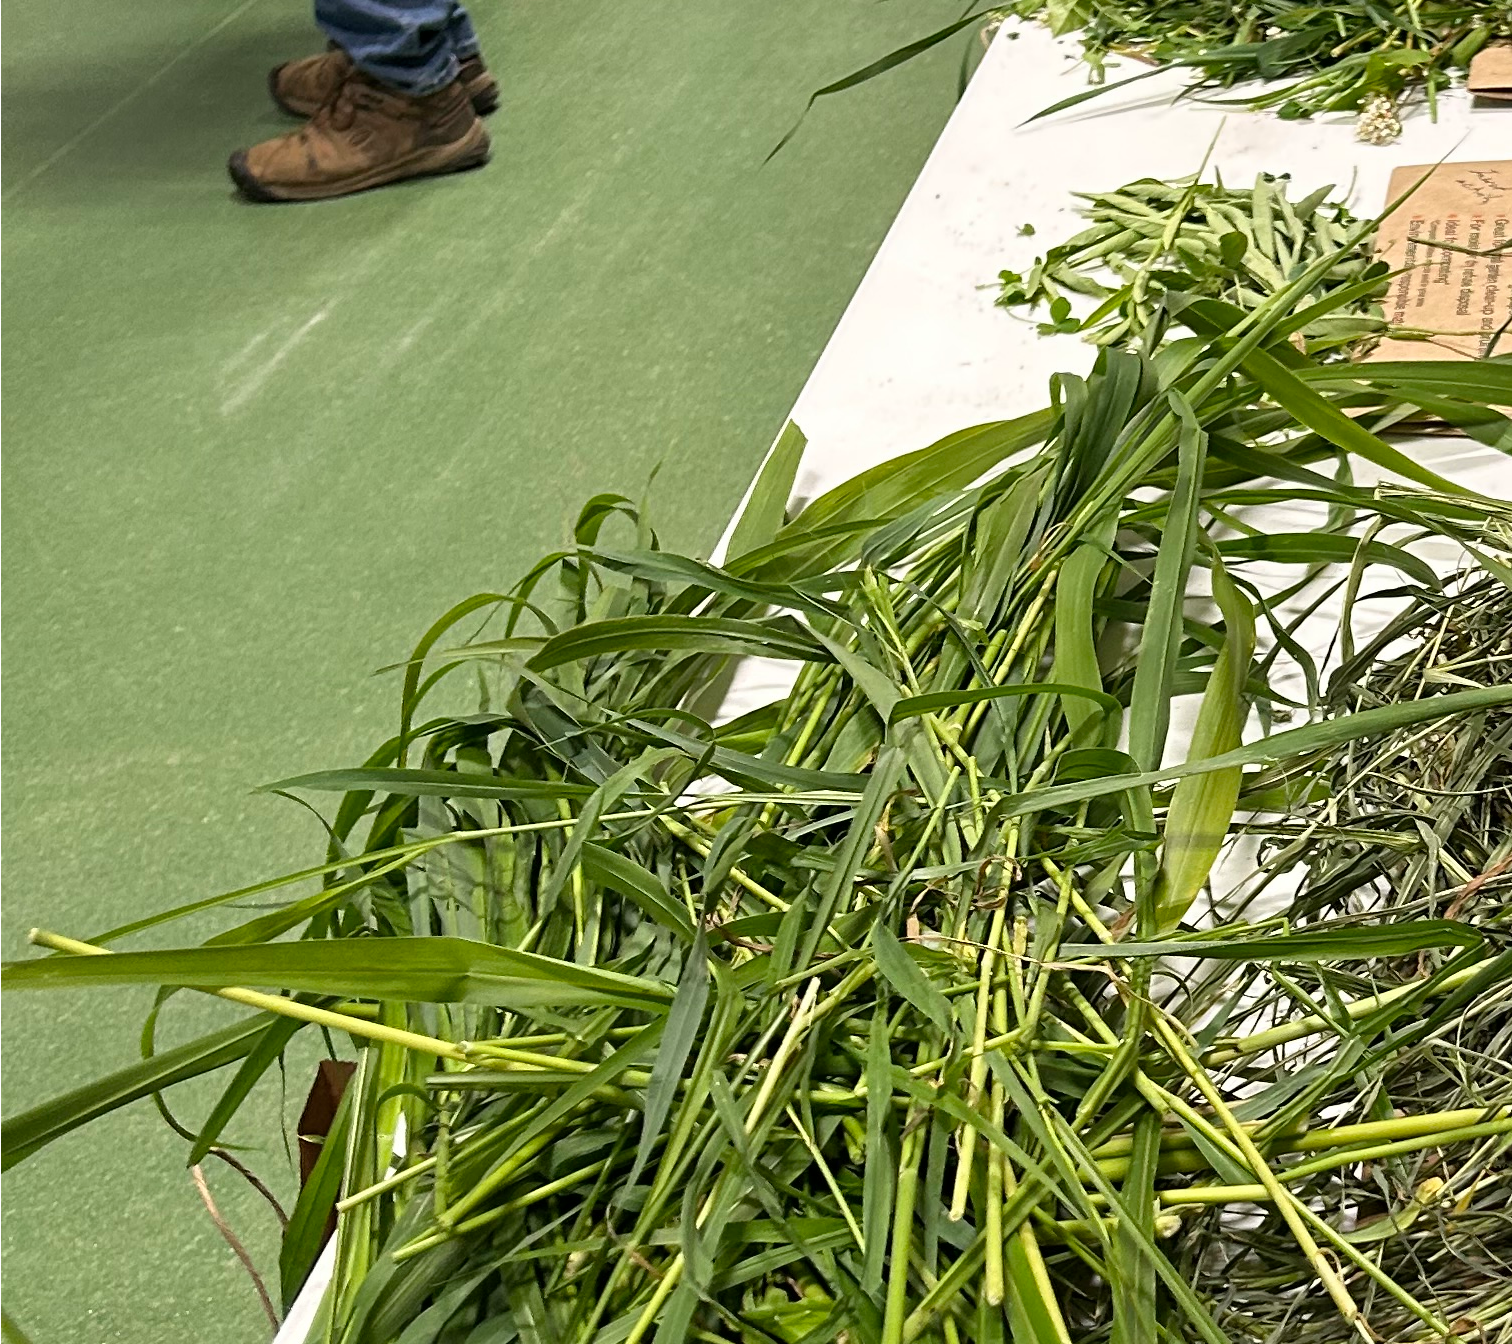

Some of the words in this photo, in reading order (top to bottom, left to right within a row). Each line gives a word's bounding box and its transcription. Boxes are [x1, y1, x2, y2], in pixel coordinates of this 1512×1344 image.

[1444, 219, 1460, 236] Ideal
[1469, 219, 1485, 231] For
[1493, 218, 1510, 238] Great
[1458, 288, 1475, 316] disposal
[1482, 284, 1501, 315] clean-up
[1482, 317, 1495, 330] and
